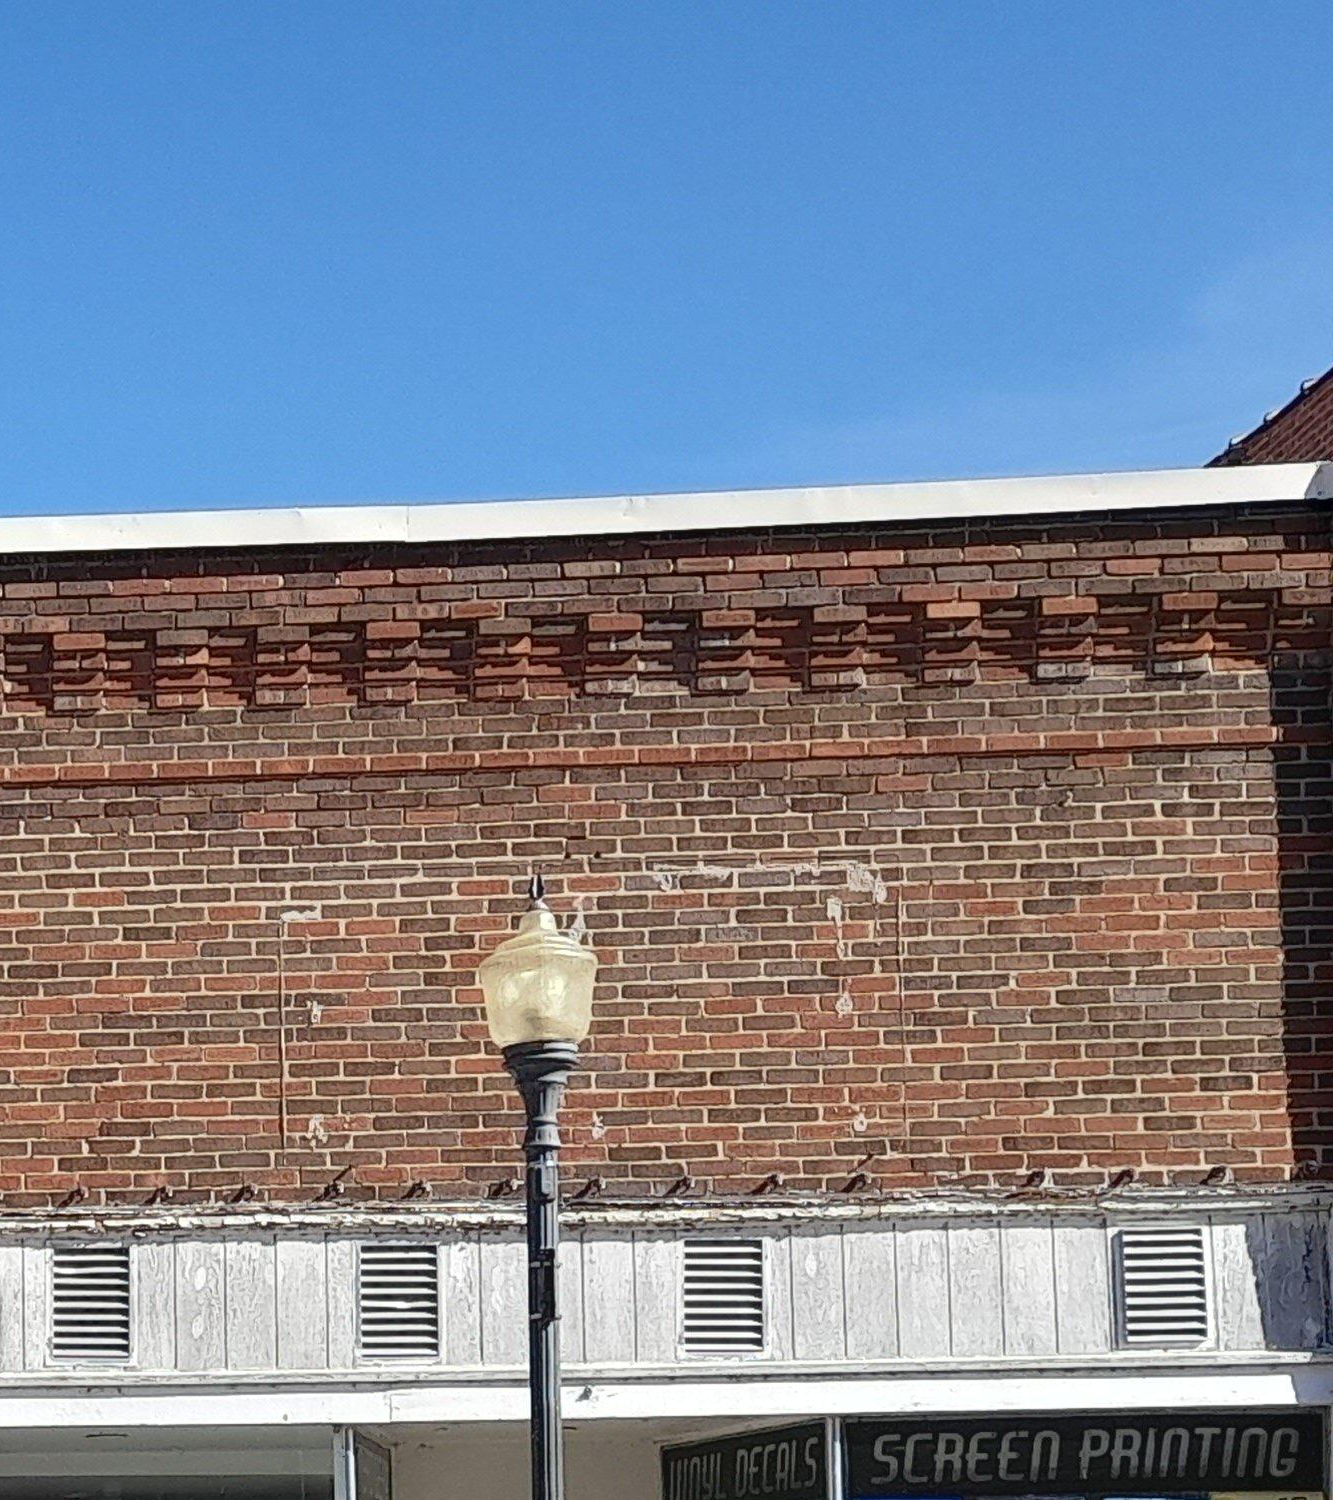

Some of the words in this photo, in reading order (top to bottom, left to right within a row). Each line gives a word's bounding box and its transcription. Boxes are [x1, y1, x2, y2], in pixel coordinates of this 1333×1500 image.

[734, 1437, 818, 1499] DECALS
[871, 1430, 1061, 1485] SCREEN
[1079, 1427, 1301, 1480] PRINTING
